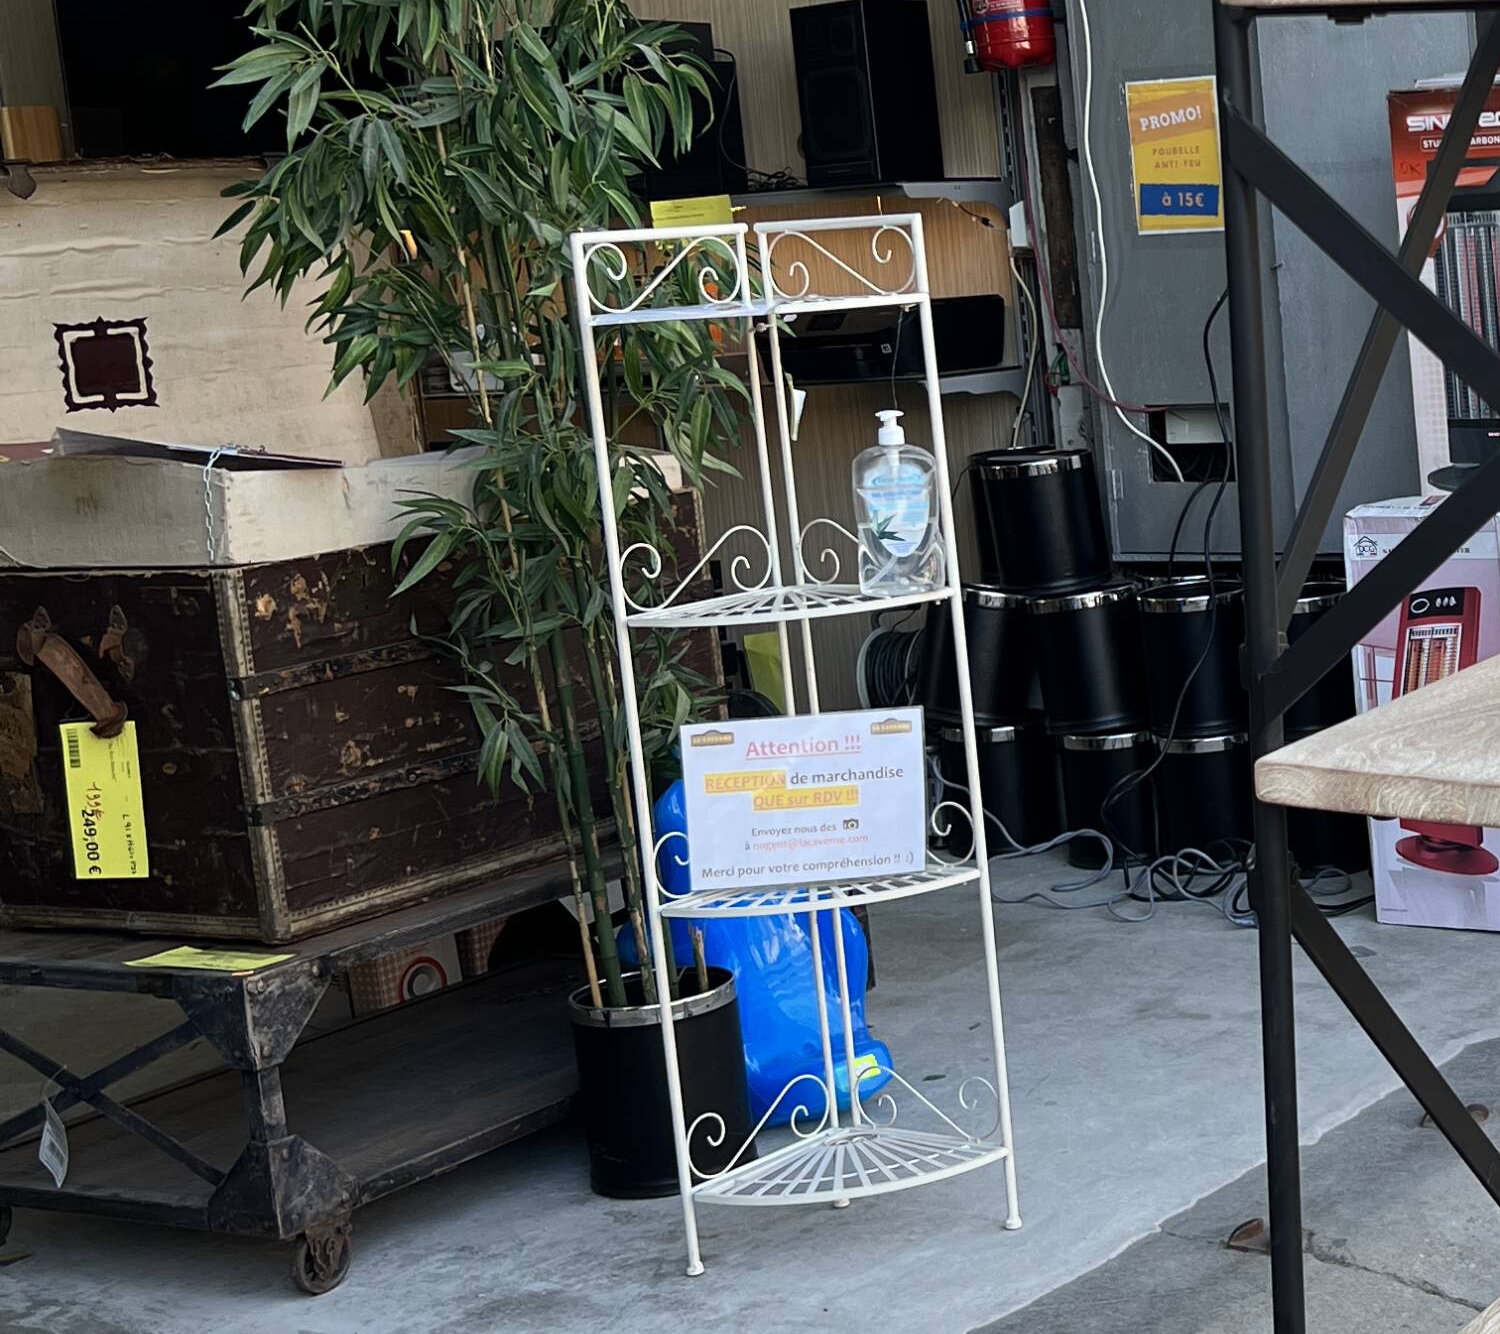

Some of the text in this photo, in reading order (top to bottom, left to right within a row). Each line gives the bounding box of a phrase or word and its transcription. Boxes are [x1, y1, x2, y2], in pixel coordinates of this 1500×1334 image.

[1139, 105, 1202, 132] PROMO!
[1152, 145, 1200, 156] POUBELLE
[1161, 191, 1205, 208] à 15€
[746, 737, 839, 757] Attention
[844, 735, 861, 751] !!!
[790, 773, 808, 785] de
[812, 766, 904, 783] marchandise
[753, 794, 784, 811] QUE
[787, 794, 809, 805] sur
[813, 790, 843, 804] RDV
[751, 822, 837, 838] Envoyez nous des
[81, 810, 102, 875] 249,00 €
[701, 864, 735, 879] Merci
[738, 866, 767, 879] pour
[768, 863, 800, 874] votre
[802, 856, 892, 873] compréhension
